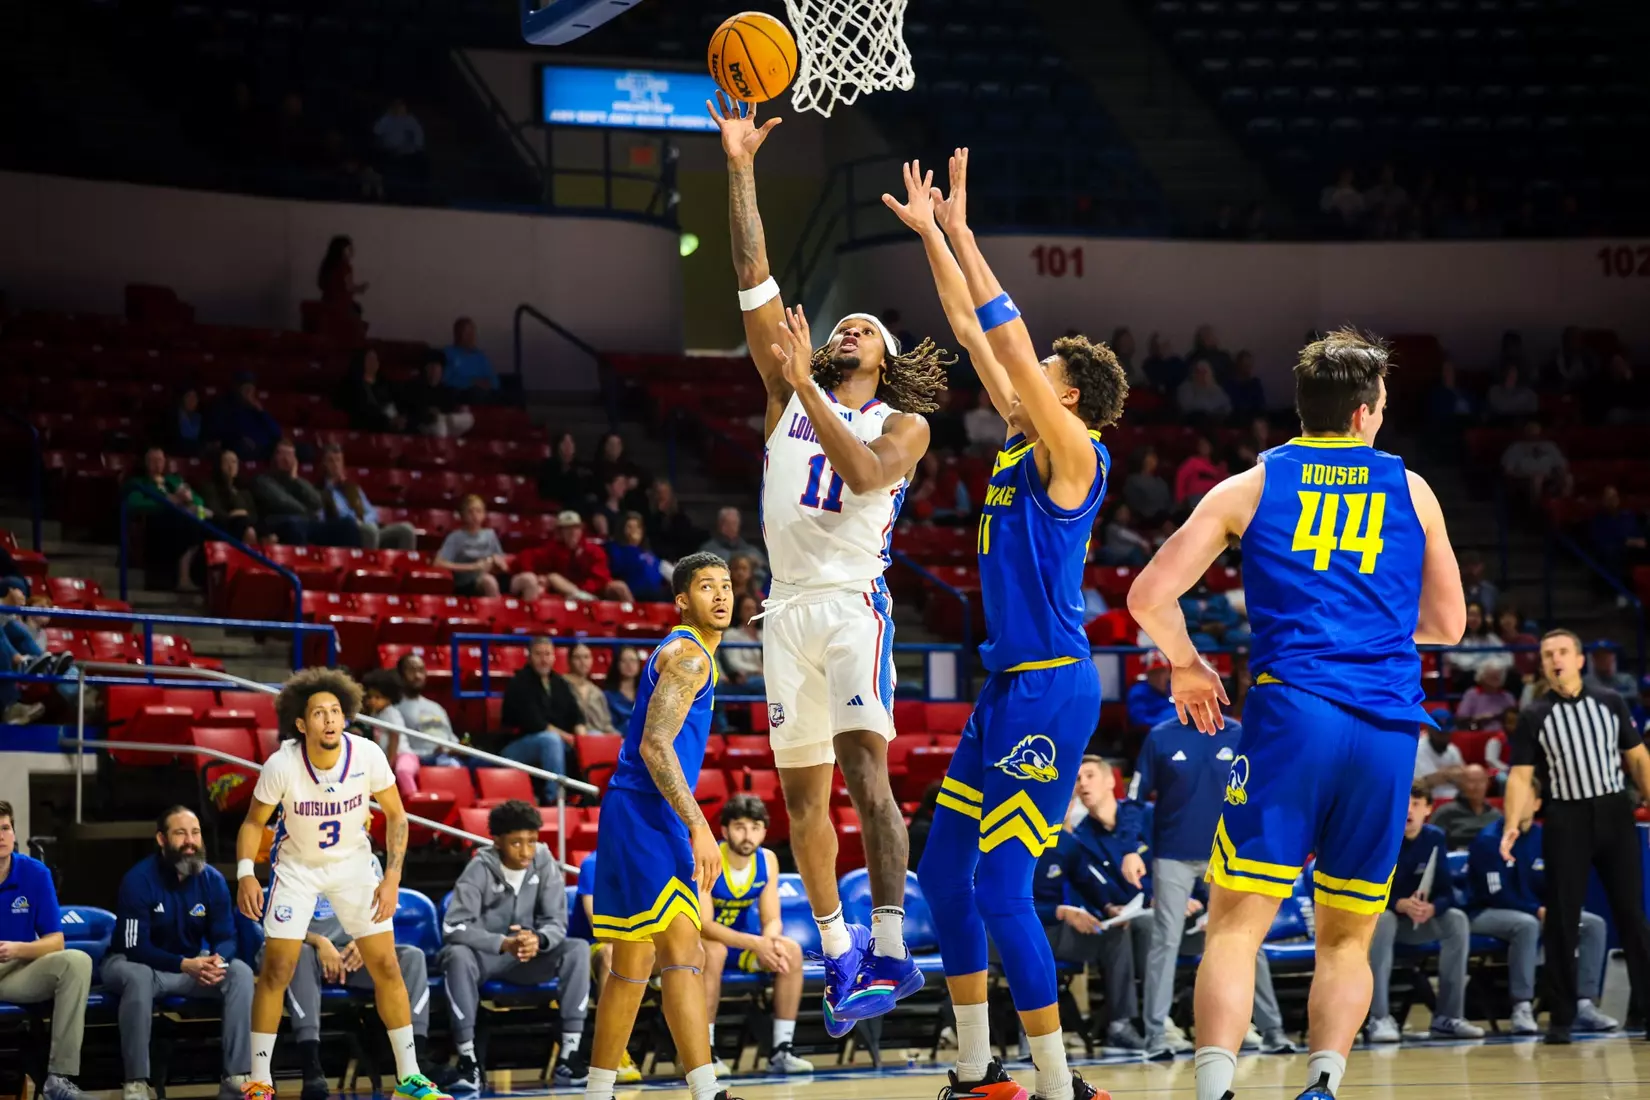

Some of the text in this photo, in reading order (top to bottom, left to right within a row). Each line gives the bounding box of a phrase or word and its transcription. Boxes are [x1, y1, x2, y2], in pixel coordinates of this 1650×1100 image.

[729, 62, 754, 98] NCAA
[1029, 244, 1084, 279] 101
[1596, 245, 1650, 279] 102
[799, 453, 845, 514] 11
[1301, 463, 1369, 485] HOUSER
[1291, 490, 1386, 575] 44
[294, 793, 363, 817] LOUISIANA TECH
[318, 820, 342, 850] 3
